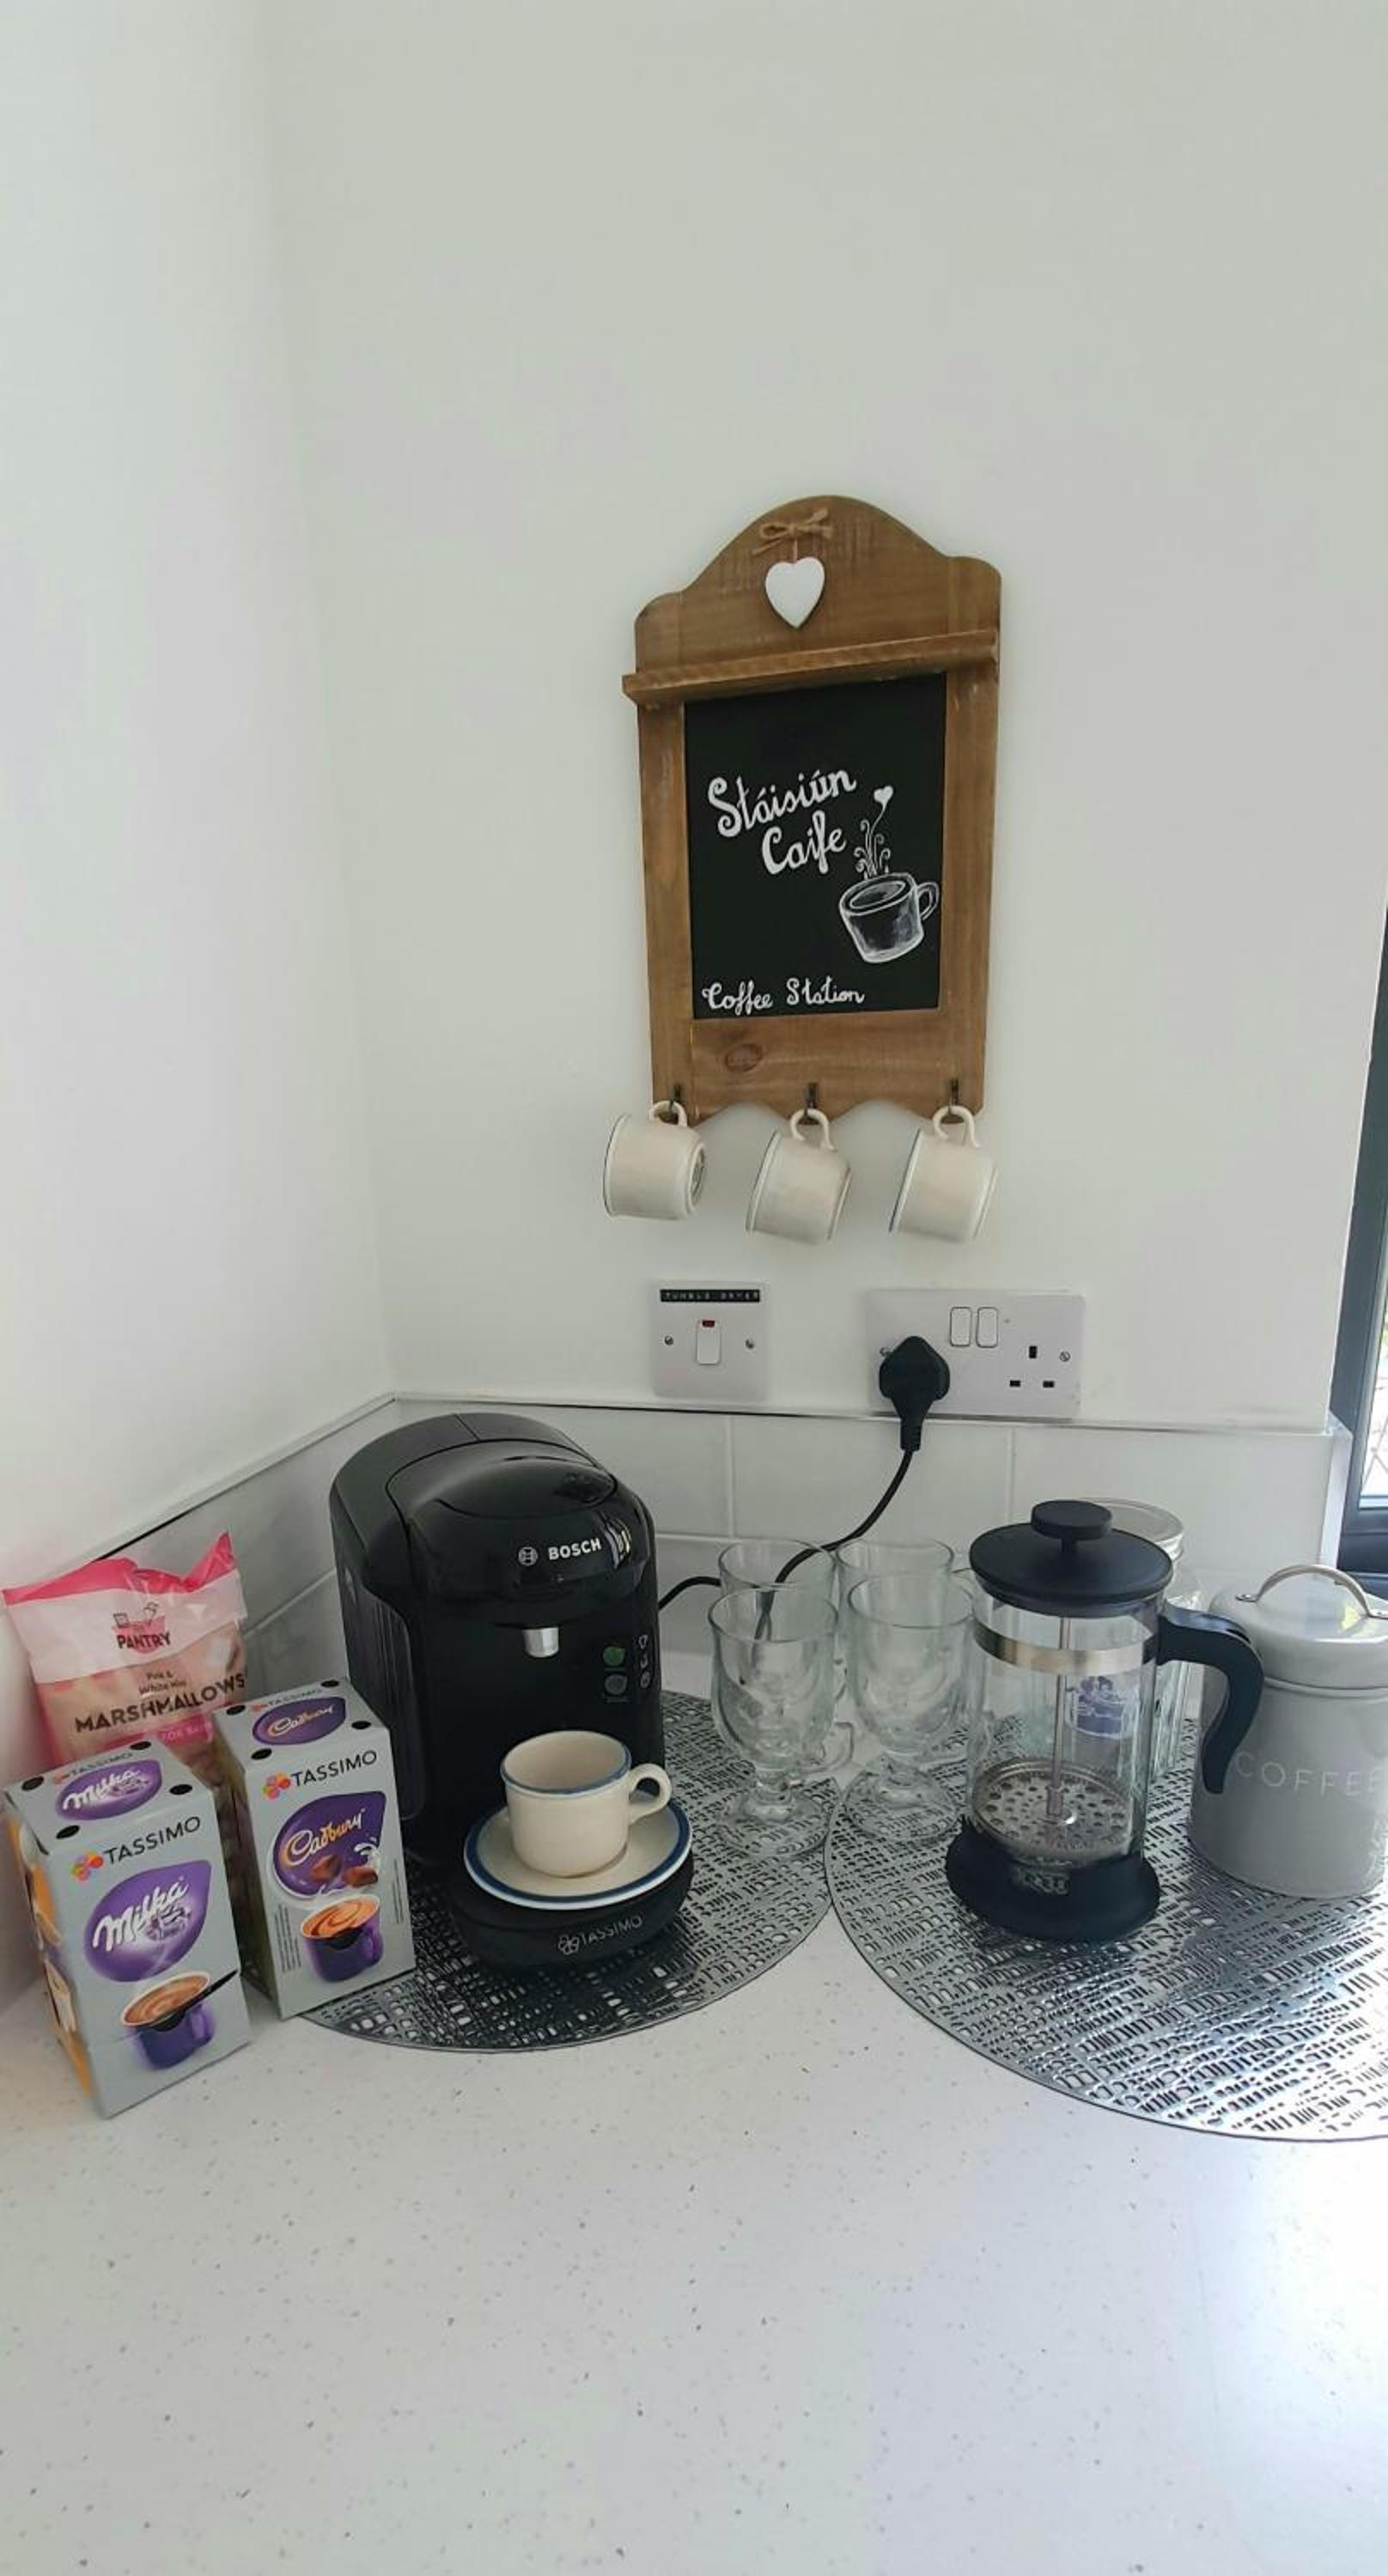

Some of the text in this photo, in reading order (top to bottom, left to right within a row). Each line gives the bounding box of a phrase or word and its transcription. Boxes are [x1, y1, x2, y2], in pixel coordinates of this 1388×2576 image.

[708, 769, 857, 838] Stáisiún
[761, 810, 847, 875] Caife
[702, 975, 865, 1016] Coffee Station
[547, 1537, 602, 1561] BOSCH
[116, 1631, 172, 1649] PANTRY
[74, 1673, 246, 1734] MARSHMALLOWS
[267, 1704, 334, 1738] Cadbury
[290, 1749, 378, 1788] TASSIMO
[63, 1769, 142, 1811] Milka
[102, 1815, 202, 1866] TASSIMO
[279, 1812, 364, 1868] Cadbury
[91, 1877, 189, 1953] Milka
[580, 1914, 643, 1946] TASSIMO
